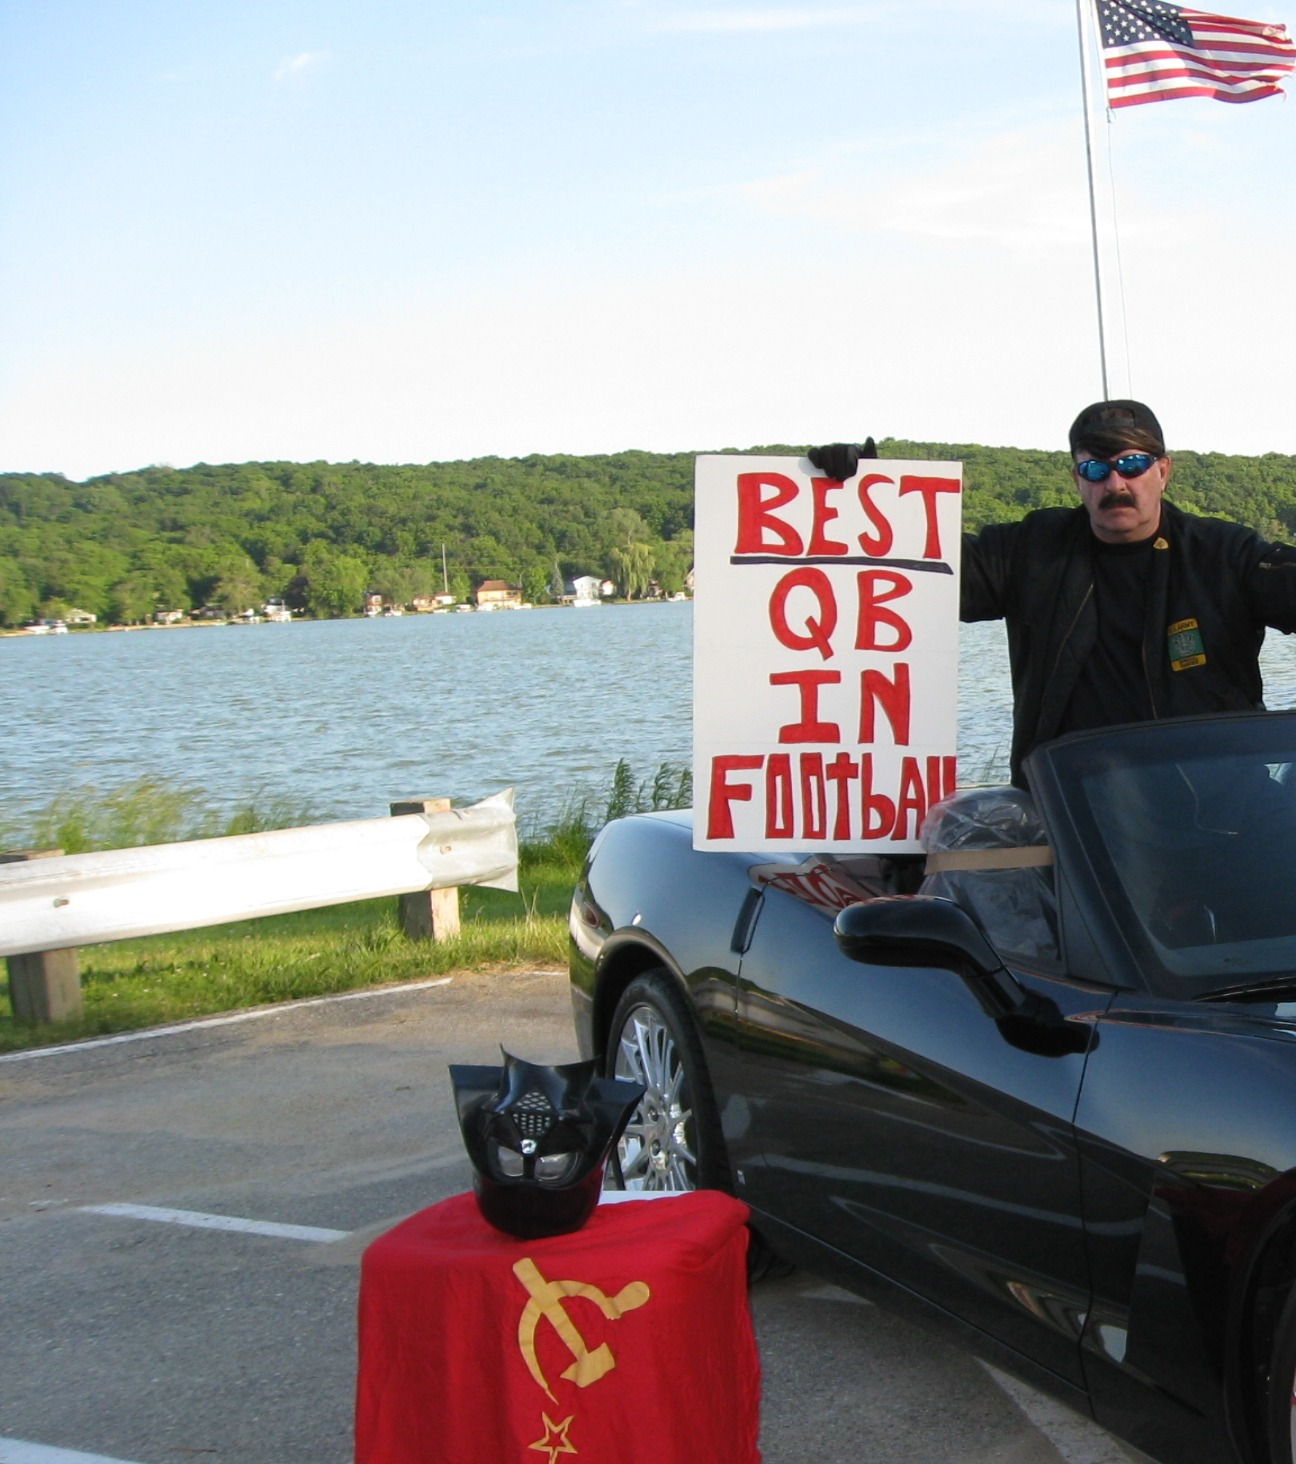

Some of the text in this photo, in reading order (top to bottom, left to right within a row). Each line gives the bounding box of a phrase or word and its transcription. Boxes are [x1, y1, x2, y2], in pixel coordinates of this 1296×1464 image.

[734, 471, 961, 560] BEST
[768, 566, 913, 661] QB
[768, 662, 911, 746] IN
